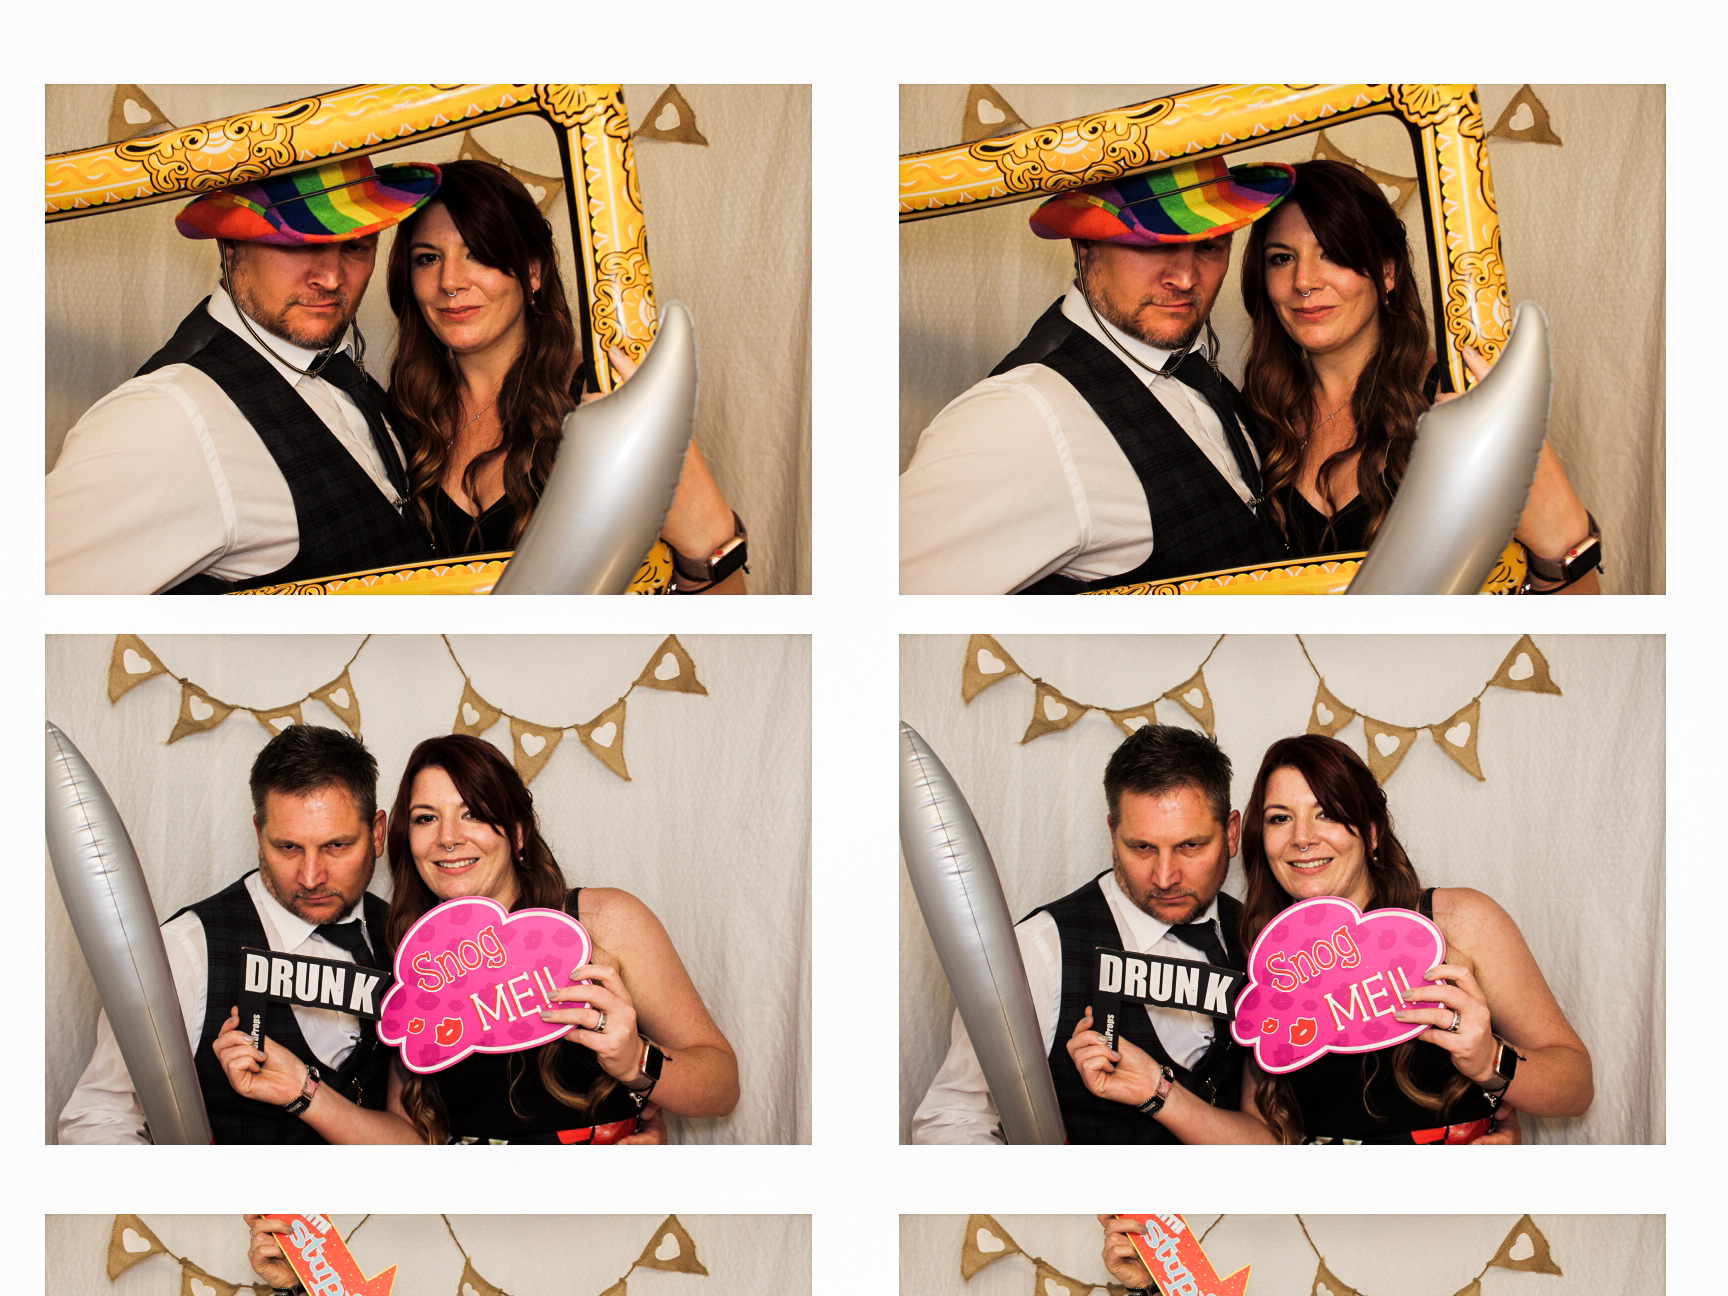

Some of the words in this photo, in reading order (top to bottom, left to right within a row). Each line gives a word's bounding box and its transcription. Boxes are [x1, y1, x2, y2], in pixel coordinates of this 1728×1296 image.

[412, 925, 508, 993] Snog
[1266, 925, 1362, 993] Snog
[300, 1214, 333, 1235] ITH
[1154, 1214, 1187, 1235] ITH
